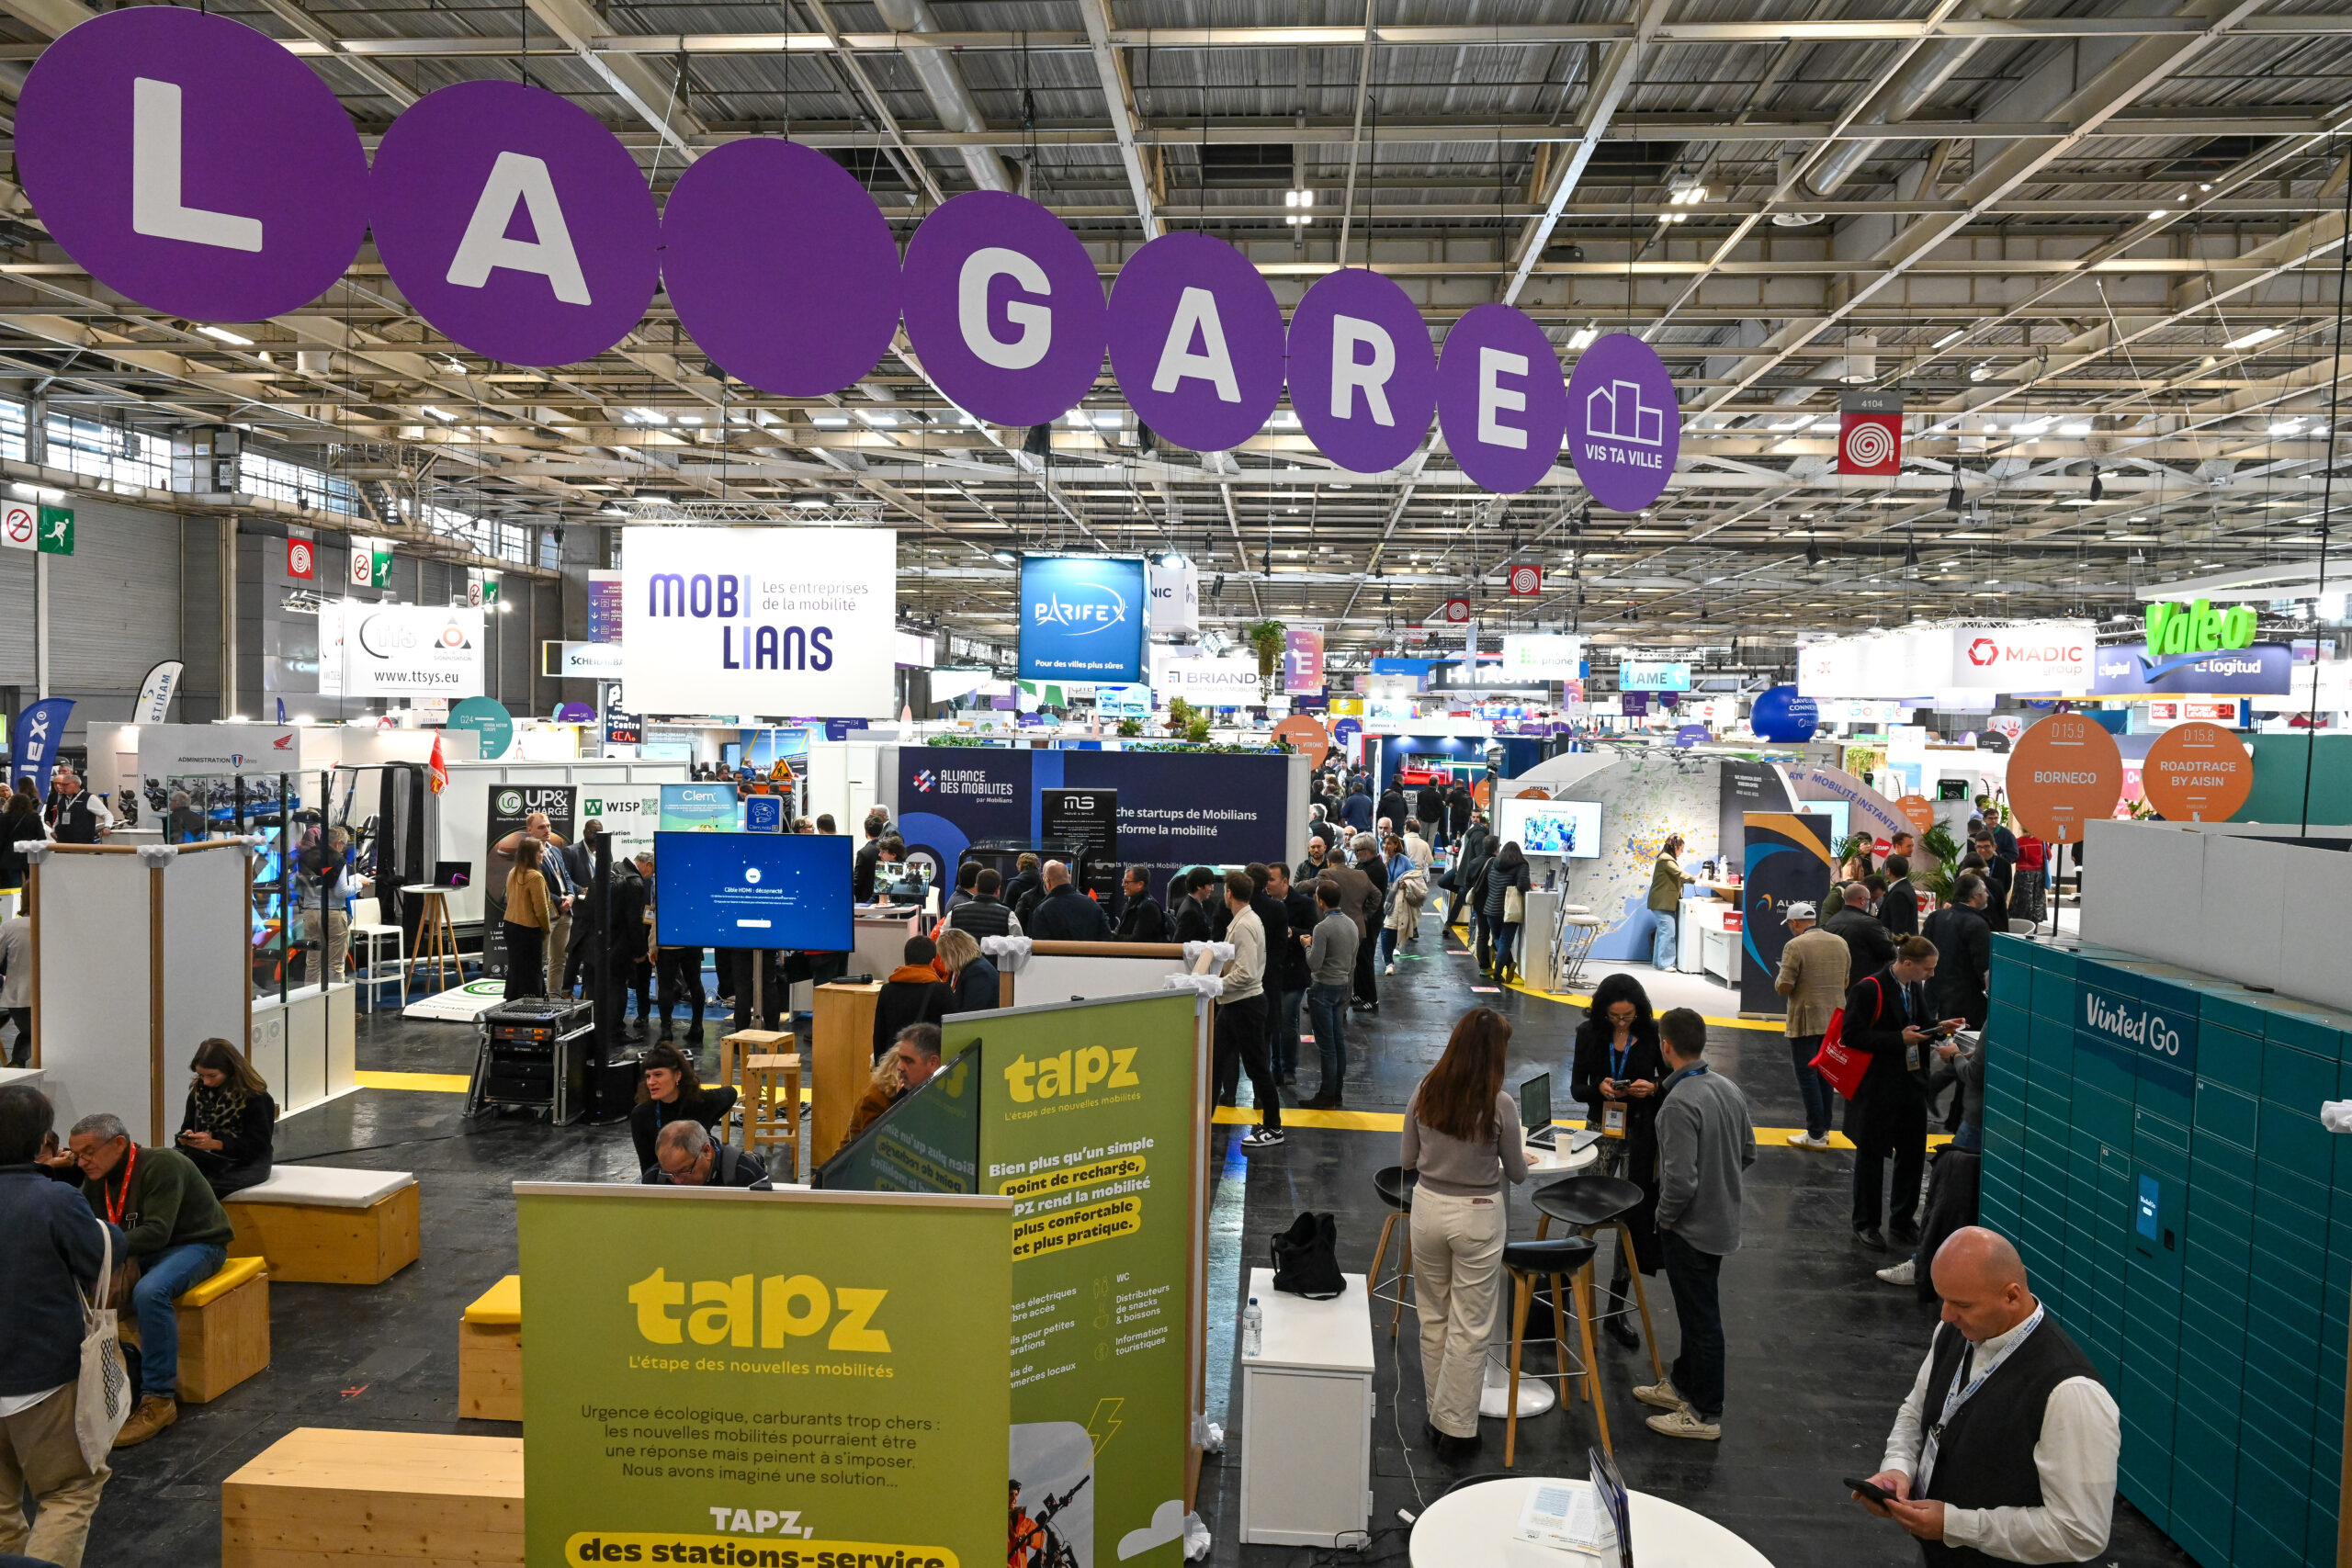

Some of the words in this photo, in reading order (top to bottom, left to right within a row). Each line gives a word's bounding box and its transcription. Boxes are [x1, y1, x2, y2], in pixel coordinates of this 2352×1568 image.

[133, 77, 592, 306] LA
[959, 246, 1530, 450] GARE
[1586, 442, 1609, 462] VIS
[1609, 446, 1627, 466] TA
[1627, 449, 1663, 470] VILLE
[763, 581, 786, 594] Les
[789, 581, 869, 597] entreprises
[762, 598, 779, 611] de
[783, 598, 796, 611] la
[799, 596, 856, 612] mobilité
[1035, 592, 1126, 626] PARIFEX
[2145, 598, 2258, 656] Valeo
[1295, 651, 1314, 675] E
[2006, 646, 2083, 662] MADIC
[1035, 659, 1053, 668] Pour
[1053, 660, 1067, 668] des
[1068, 660, 1087, 669] villes
[1087, 660, 1103, 671] plus
[1103, 660, 1124, 671] sûres
[2042, 664, 2083, 676] group
[2209, 659, 2262, 676] logitud
[374, 671, 459, 685] www.ttsys.eu
[1186, 671, 1258, 684] BRIAND
[151, 673, 171, 722] STIRAM
[1847, 701, 1902, 721] Gogle
[2185, 704, 2213, 713] Berger
[2185, 709, 2218, 718] Levrault
[460, 715, 474, 724] G24
[608, 714, 629, 723] Parking
[2052, 723, 2059, 739] D
[2062, 723, 2085, 739] 15.9
[2184, 728, 2191, 741] D
[2193, 728, 2214, 742] 15.8
[177, 756, 231, 764] ADMINISTRATION
[2160, 761, 2236, 773] ROADTRACE
[940, 769, 986, 783] ALLIANCE
[2034, 771, 2097, 784] BORNECO
[2171, 776, 2188, 786] BY
[2190, 776, 2224, 787] AISIN
[940, 782, 959, 794] DES
[961, 782, 1013, 795] MOBILITES
[1812, 773, 1859, 803] MOBILITÉ
[525, 807, 569, 816] CHARGE
[605, 801, 640, 812] WISP
[1136, 808, 1184, 821] startups
[1186, 807, 1200, 819] de
[1203, 807, 1258, 820] Mobilians
[1116, 823, 1157, 835] sforme
[1159, 823, 1169, 835] la
[1171, 824, 1218, 836] mobilité
[2086, 992, 2147, 1045] Vinted
[2149, 1017, 2179, 1056] Go
[1004, 1044, 1140, 1103] tapz
[1004, 1107, 1038, 1122] L'étape
[1040, 1104, 1057, 1115] des
[1057, 1098, 1100, 1113] nouvelles
[1101, 1091, 1141, 1106] mobilités
[989, 1161, 1025, 1178] Bien
[1029, 1155, 1060, 1173] plus
[1063, 1145, 1104, 1167] qu'un
[1106, 1135, 1154, 1156] simple
[1006, 1179, 1047, 1196] point
[1050, 1172, 1069, 1187] de
[1071, 1159, 1140, 1184] recharge,
[1013, 1201, 1035, 1217] PZ
[1037, 1191, 1072, 1212] rend
[1075, 1190, 1089, 1203] la
[1091, 1176, 1151, 1201] mobilité
[1013, 1221, 1046, 1241] plus
[1048, 1201, 1134, 1230] confortable
[1012, 1242, 1030, 1256] et
[1033, 1234, 1064, 1254] plus
[1067, 1219, 1134, 1246] pratique.
[1116, 1272, 1130, 1283] WC
[1027, 1287, 1077, 1308] électriques
[1115, 1284, 1170, 1304] Distributeurs
[628, 1267, 892, 1354] tapz
[1029, 1303, 1056, 1318] accès
[1115, 1305, 1126, 1314] de
[1128, 1297, 1159, 1312] snacks
[1115, 1315, 1123, 1325] &
[1124, 1307, 1161, 1323] boissons
[1022, 1330, 1042, 1344] pour
[1043, 1320, 1076, 1336] petites
[1115, 1325, 1169, 1346] Informations
[1115, 1337, 1166, 1356] touristiques
[629, 1355, 690, 1374] L'étape
[695, 1357, 725, 1371] des
[730, 1359, 810, 1375] nouvelles
[815, 1361, 894, 1378] mobilités
[1022, 1364, 1034, 1375] de
[1046, 1361, 1077, 1378] locaux
[581, 1404, 650, 1422] Urgence
[653, 1405, 750, 1427] écologique,
[752, 1408, 842, 1428] carburants
[847, 1414, 881, 1432] trop
[886, 1416, 933, 1431] chers
[935, 1419, 942, 1431] :
[605, 1423, 628, 1439] les
[633, 1425, 710, 1442] nouvelles
[714, 1427, 788, 1445] mobilités
[792, 1430, 877, 1450] pourraient
[882, 1432, 916, 1450] être
[605, 1445, 636, 1459] une
[640, 1444, 707, 1464] réponse
[712, 1447, 749, 1462] mais
[752, 1449, 816, 1468] peinent
[820, 1450, 831, 1465] à
[833, 1450, 916, 1472] s'imposer.
[622, 1462, 663, 1478] Nous
[668, 1464, 714, 1480] avons
[718, 1465, 781, 1485] imaginé
[786, 1471, 816, 1483] une
[820, 1470, 899, 1489] solution...
[709, 1506, 815, 1540] TAPZ,
[578, 1538, 642, 1563] des
[651, 1541, 945, 1568] stations-service
